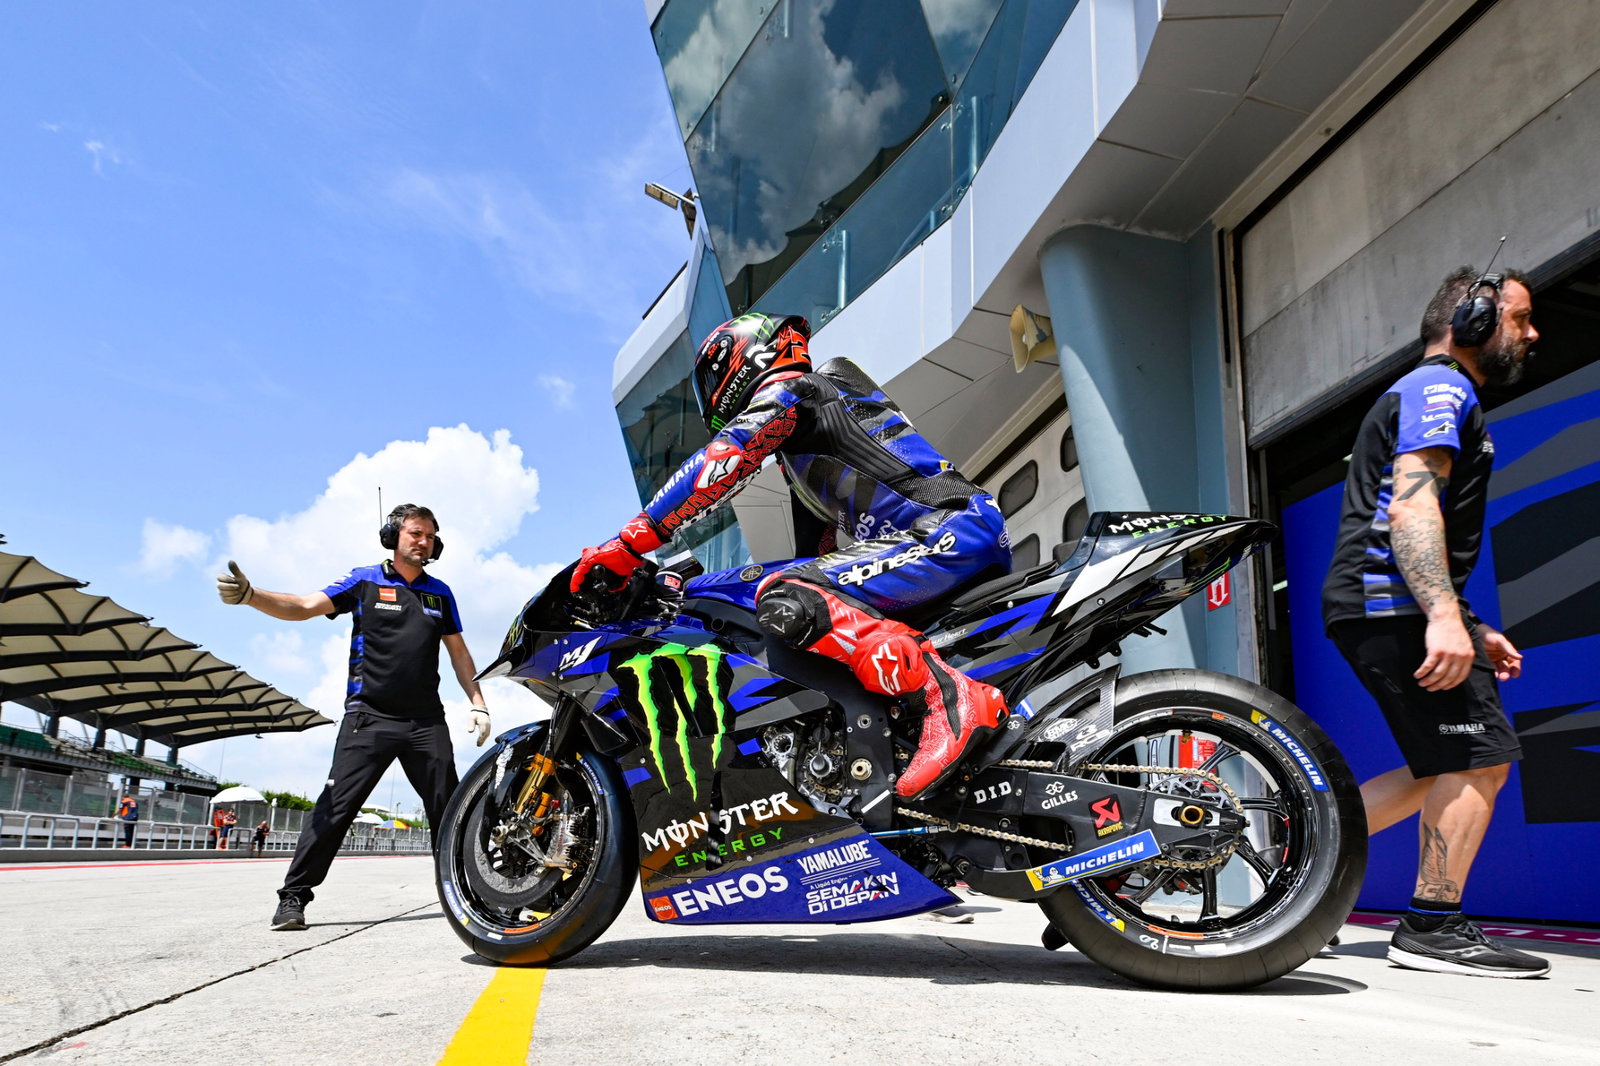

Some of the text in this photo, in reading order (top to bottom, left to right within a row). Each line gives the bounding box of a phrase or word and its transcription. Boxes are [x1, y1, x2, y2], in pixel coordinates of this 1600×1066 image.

[718, 365, 752, 414] MONSTER
[643, 452, 706, 512] YAMAHA
[838, 510, 847, 533] STER
[855, 512, 876, 541] EOS
[1108, 513, 1200, 534] MONS
[1131, 515, 1229, 540] ENERGY
[837, 532, 957, 586] alpinestars
[1271, 728, 1323, 786] MICHELIN
[974, 781, 1012, 804] D.I.D
[1041, 790, 1078, 810] GILLES
[641, 791, 799, 852] MONSTER
[674, 827, 782, 867] ENERGY
[797, 840, 872, 875] YAMALUBE
[1065, 840, 1145, 875] MICHELIN
[672, 866, 789, 917] ENEOS
[815, 880, 831, 889] Liquid
[830, 883, 900, 910] DEPAN
[1074, 882, 1104, 913] MICH
